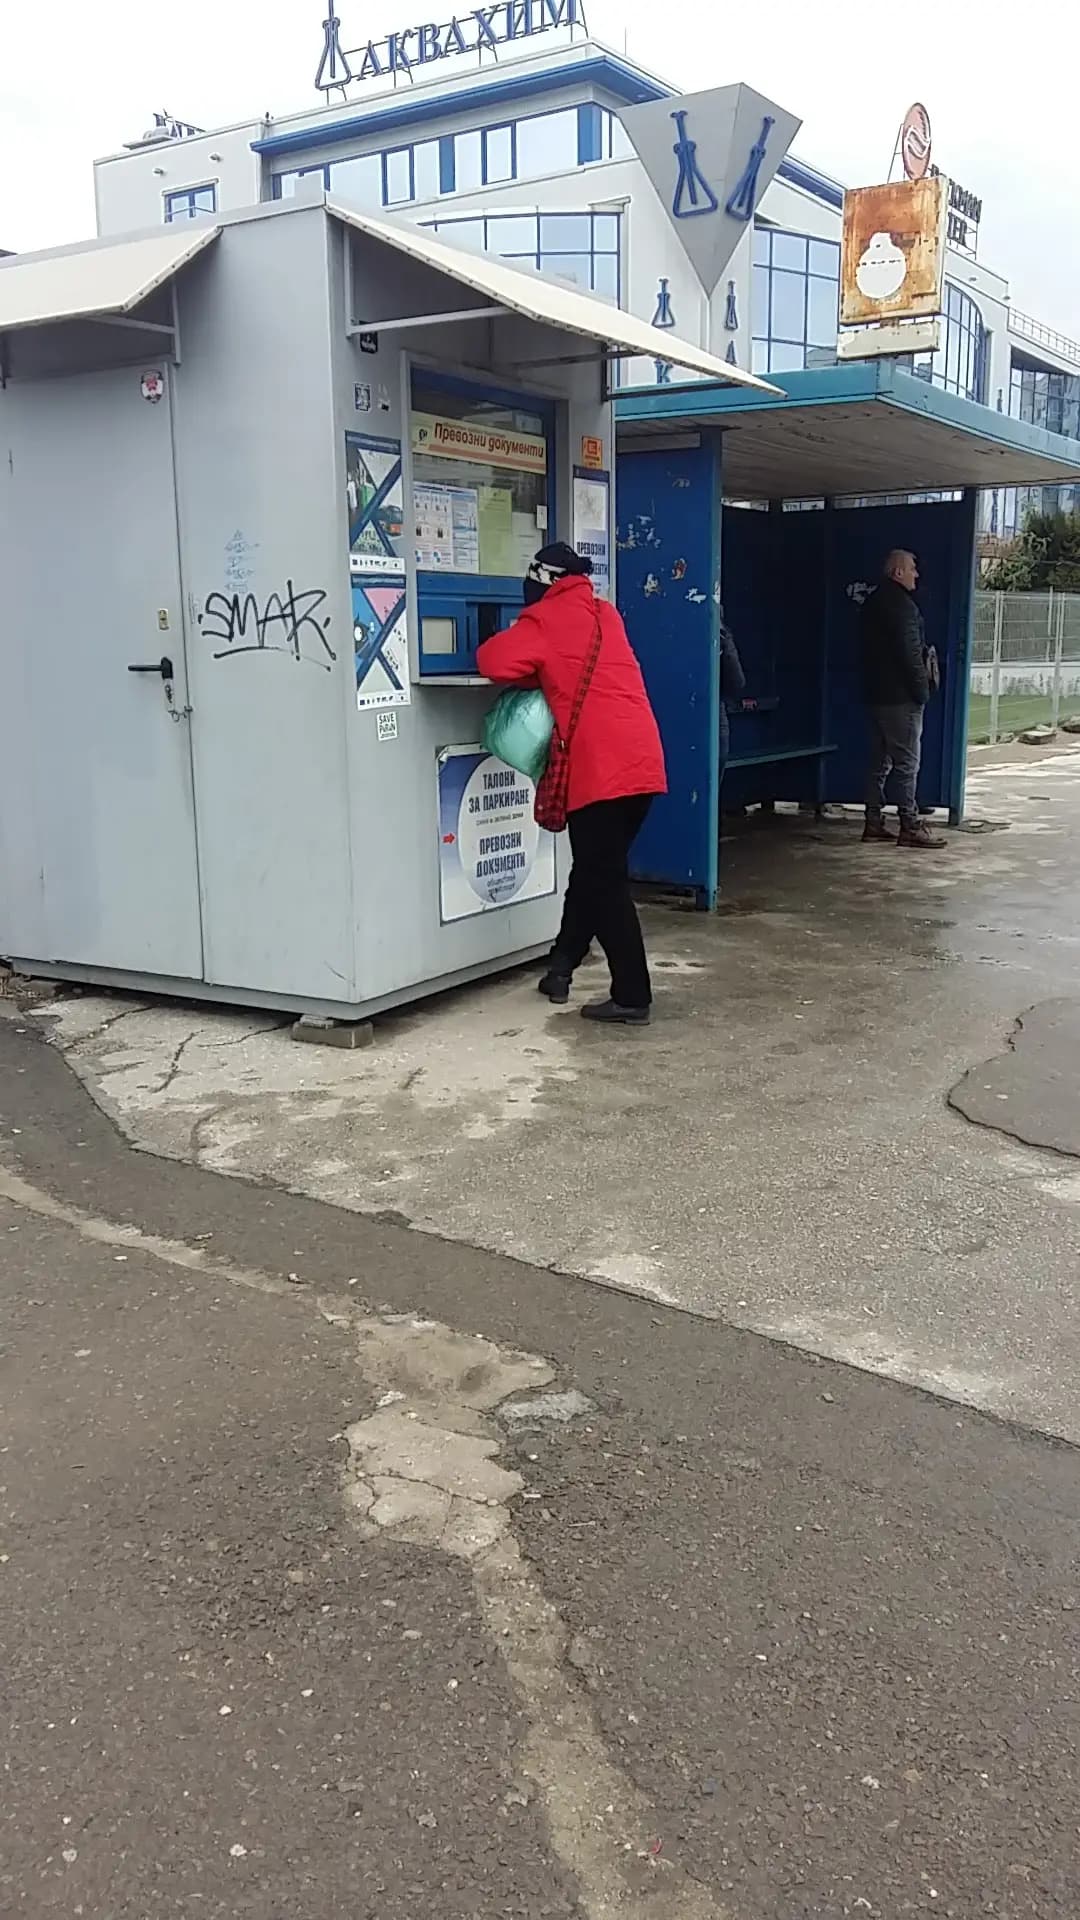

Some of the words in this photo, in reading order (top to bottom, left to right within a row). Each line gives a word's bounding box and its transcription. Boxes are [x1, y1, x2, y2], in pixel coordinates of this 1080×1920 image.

[356, 0, 578, 81] АКВАХИМ
[434, 422, 487, 443] Превозни
[488, 437, 544, 458] документи
[379, 713, 394, 725] SAVE
[483, 770, 515, 790] ТАЛОНИ
[469, 796, 480, 813] ЗА
[483, 788, 529, 811] ПАРКИРАНЕ
[479, 831, 521, 855] ПРЕВОЗНИ
[476, 852, 525, 878] ДОКУМЕНТИ
